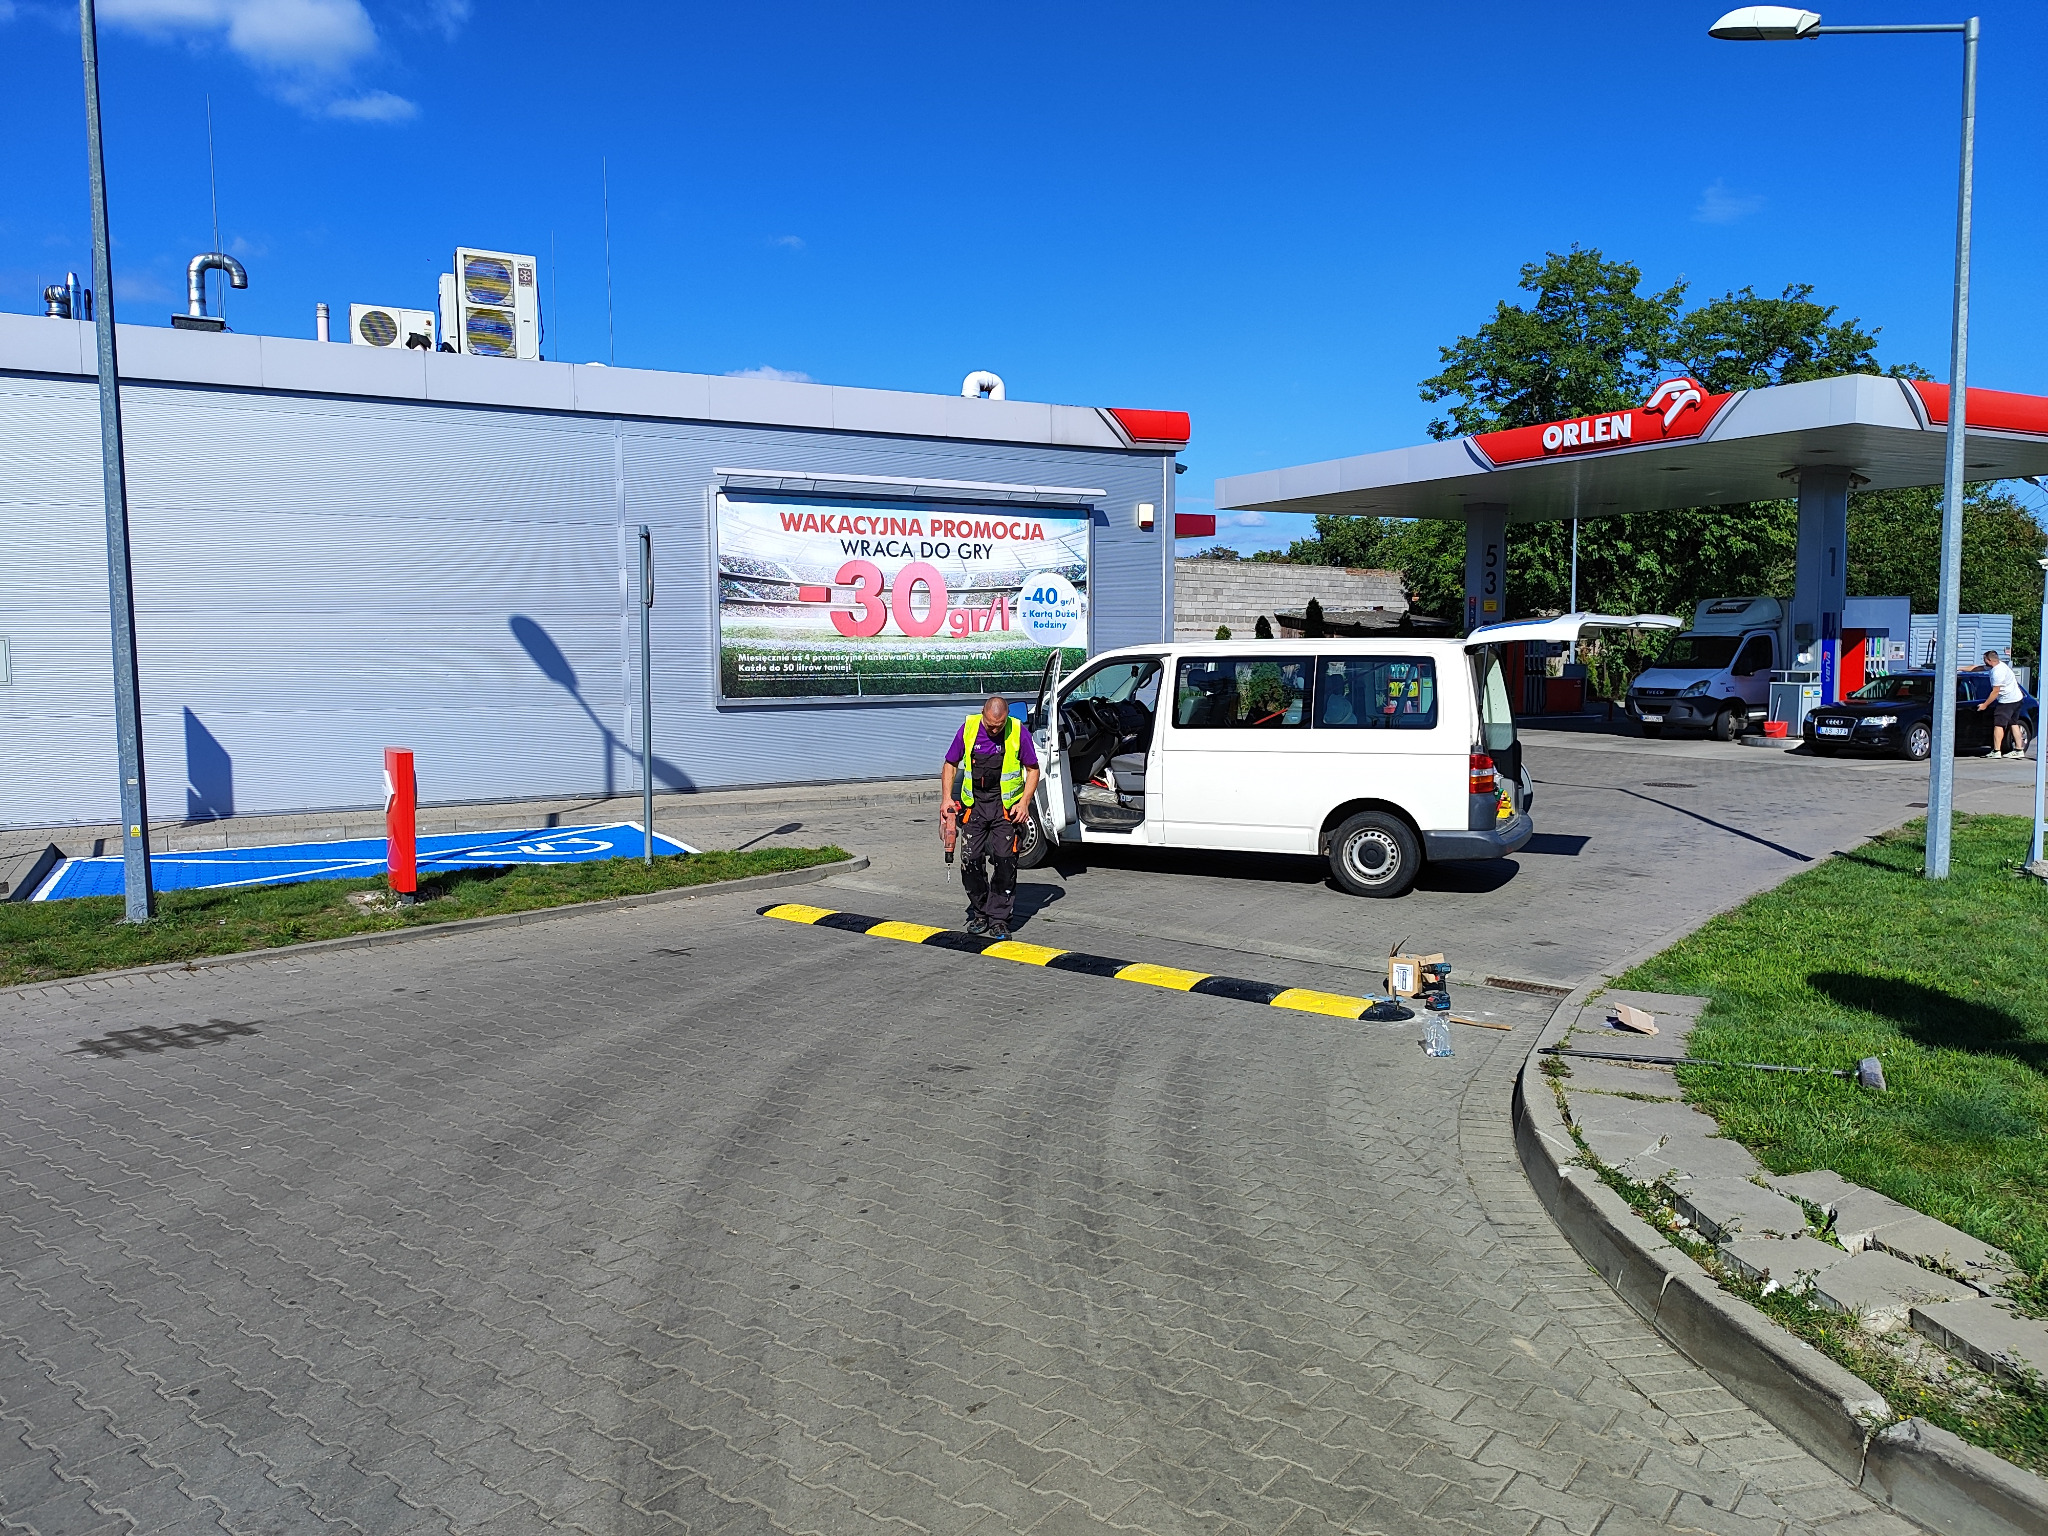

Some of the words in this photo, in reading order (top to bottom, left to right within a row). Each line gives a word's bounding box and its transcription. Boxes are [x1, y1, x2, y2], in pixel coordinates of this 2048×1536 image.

[1542, 413, 1632, 450] ORLEN
[780, 512, 923, 537] WAKACYJNA
[930, 519, 1044, 541] PROMOCJA
[840, 538, 914, 558] WRACA
[920, 541, 950, 559] DO
[957, 543, 993, 560] GRY
[1485, 544, 1498, 568] 5
[1828, 547, 1837, 577] 1
[1484, 571, 1497, 595] 3
[799, 559, 948, 638] -30
[948, 597, 1009, 639] gr/l
[1024, 587, 1058, 605] -40
[1060, 597, 1075, 607] gr/l
[1029, 609, 1053, 619] Kartą
[1055, 609, 1078, 620] Dużej
[1033, 620, 1067, 630] Rodziny
[738, 653, 790, 663] Miesięcznie
[792, 653, 803, 662] aż
[804, 654, 811, 662] 4
[812, 654, 863, 663] promocyjne
[865, 653, 914, 661] tankowania
[922, 653, 969, 662] Programem
[738, 663, 767, 672] Każde
[769, 663, 781, 672] do
[783, 663, 795, 672] 50
[797, 662, 823, 671] litrów
